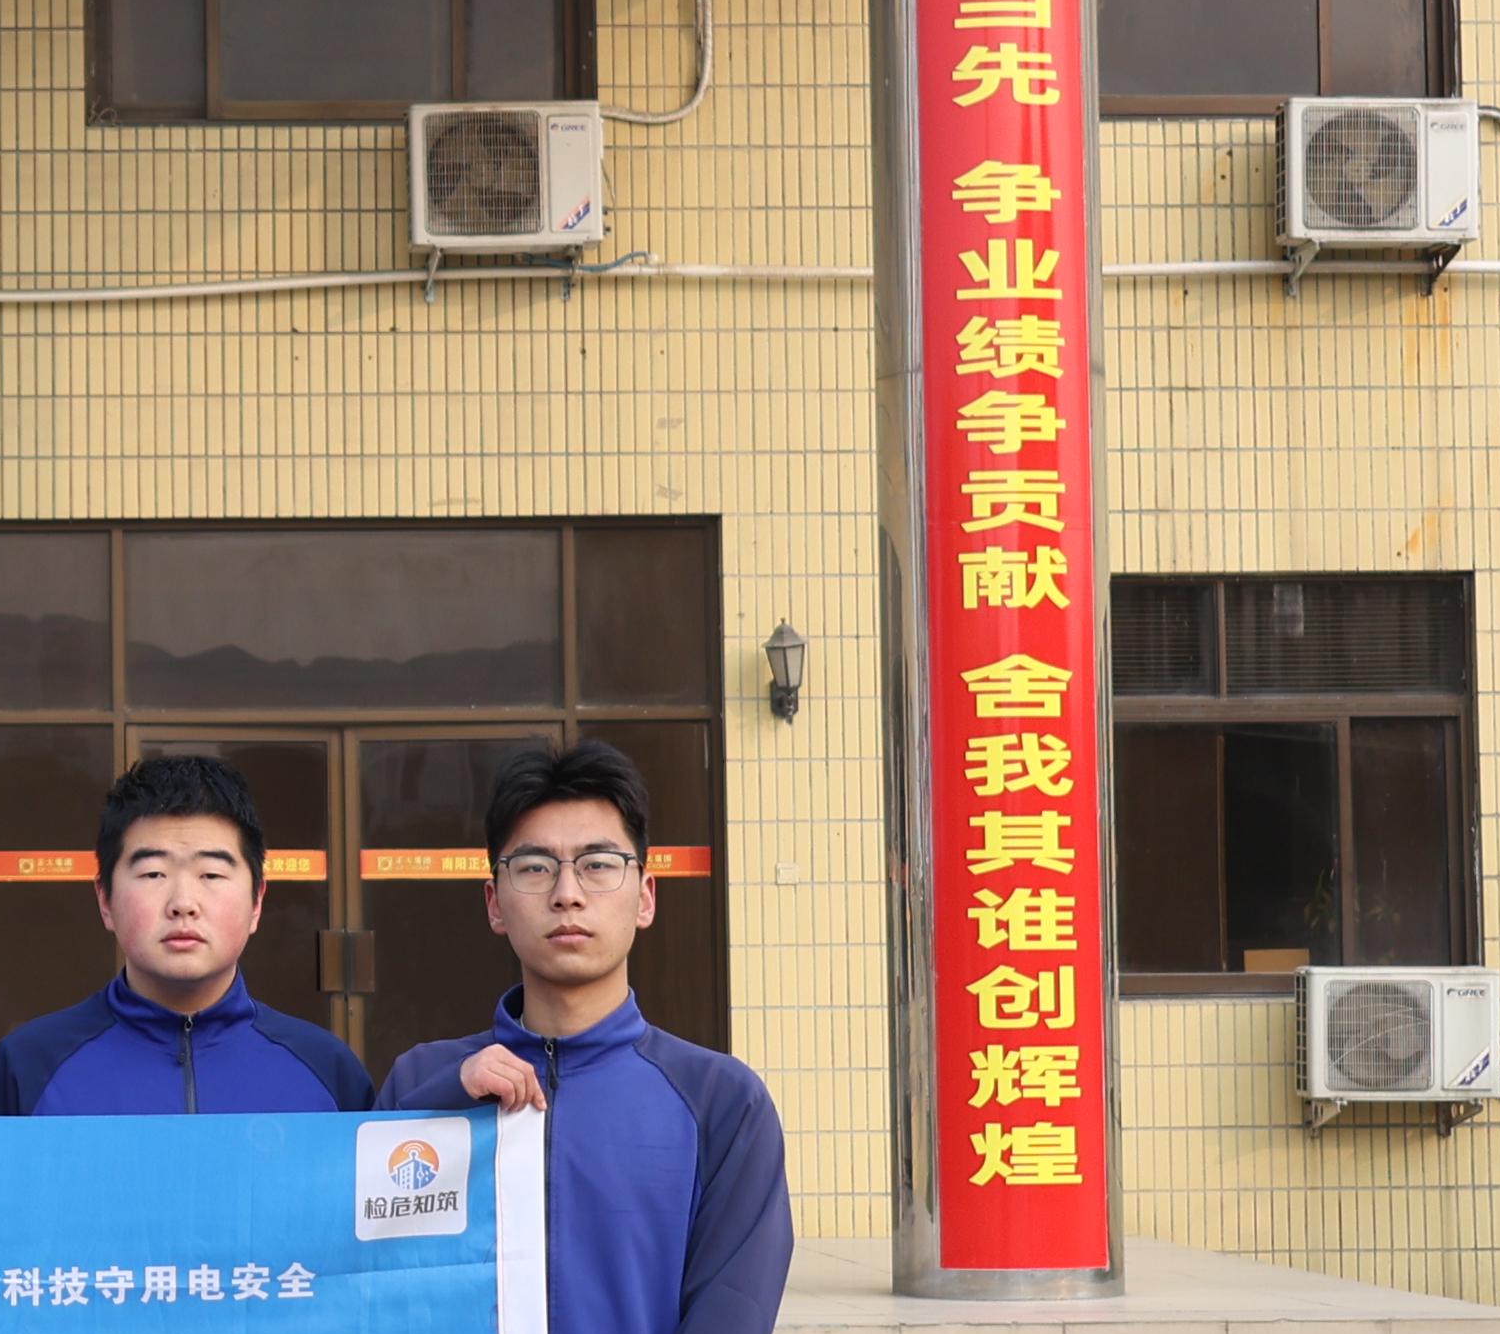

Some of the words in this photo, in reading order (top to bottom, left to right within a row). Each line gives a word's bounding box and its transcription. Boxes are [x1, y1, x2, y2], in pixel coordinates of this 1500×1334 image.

[951, 159, 1071, 610] 争业绩争贡献
[960, 653, 1083, 1186] 舍我其谁创辉煌
[363, 1190, 458, 1219] 检危知筑
